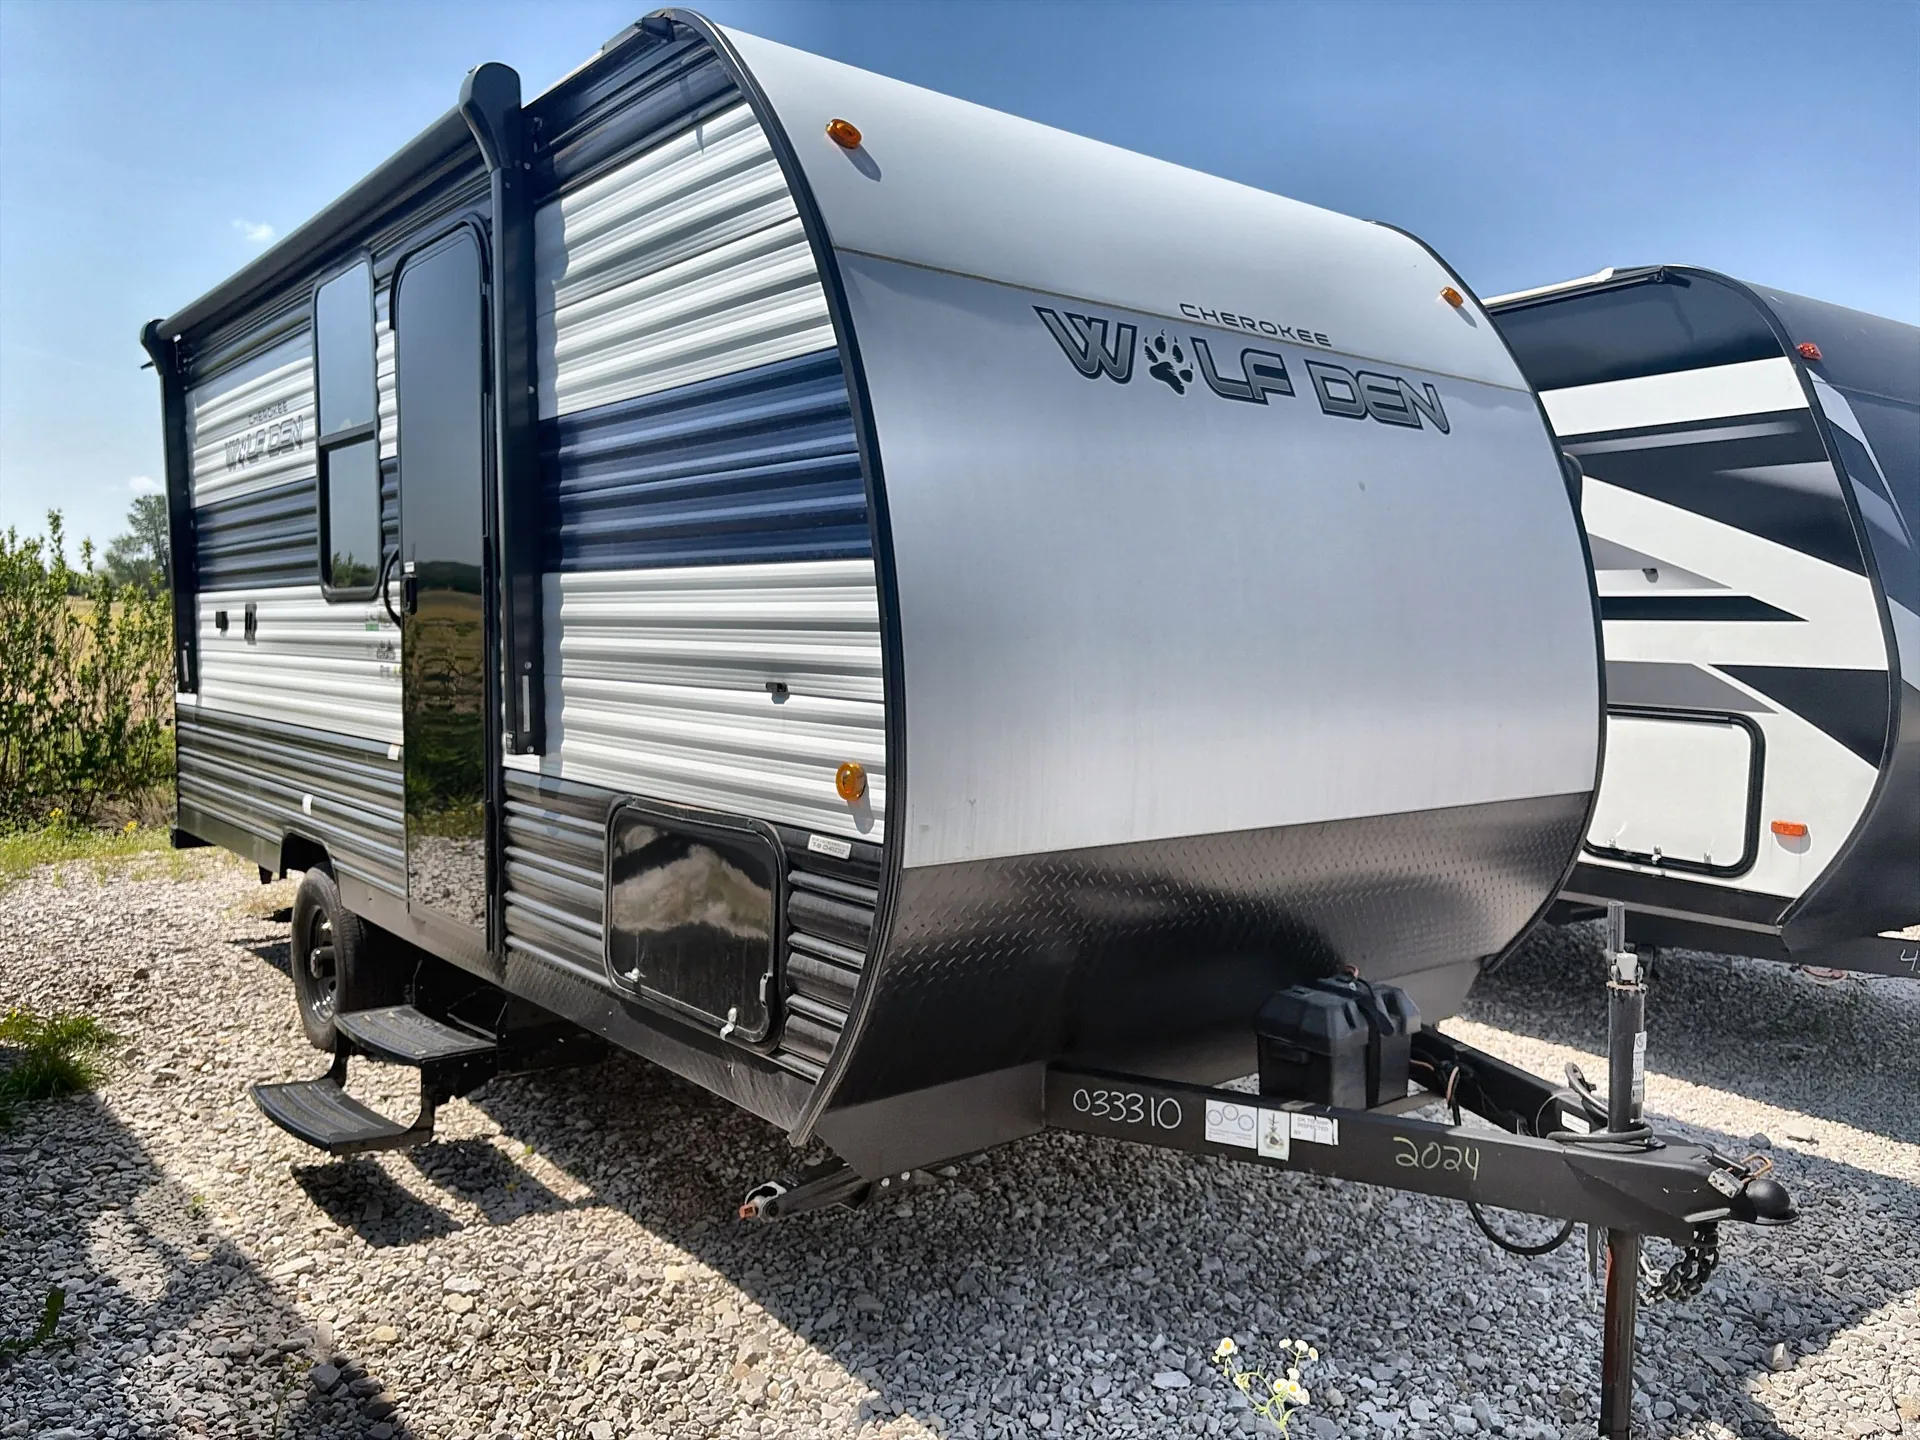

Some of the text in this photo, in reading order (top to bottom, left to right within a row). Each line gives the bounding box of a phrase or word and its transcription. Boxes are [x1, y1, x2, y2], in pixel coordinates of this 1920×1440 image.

[1179, 302, 1332, 348] CHEROKEE
[1304, 358, 1451, 435] DEN
[268, 414, 304, 458] DEN
[1073, 1088, 1182, 1130] 033310
[1393, 1136, 1480, 1181] 2024
